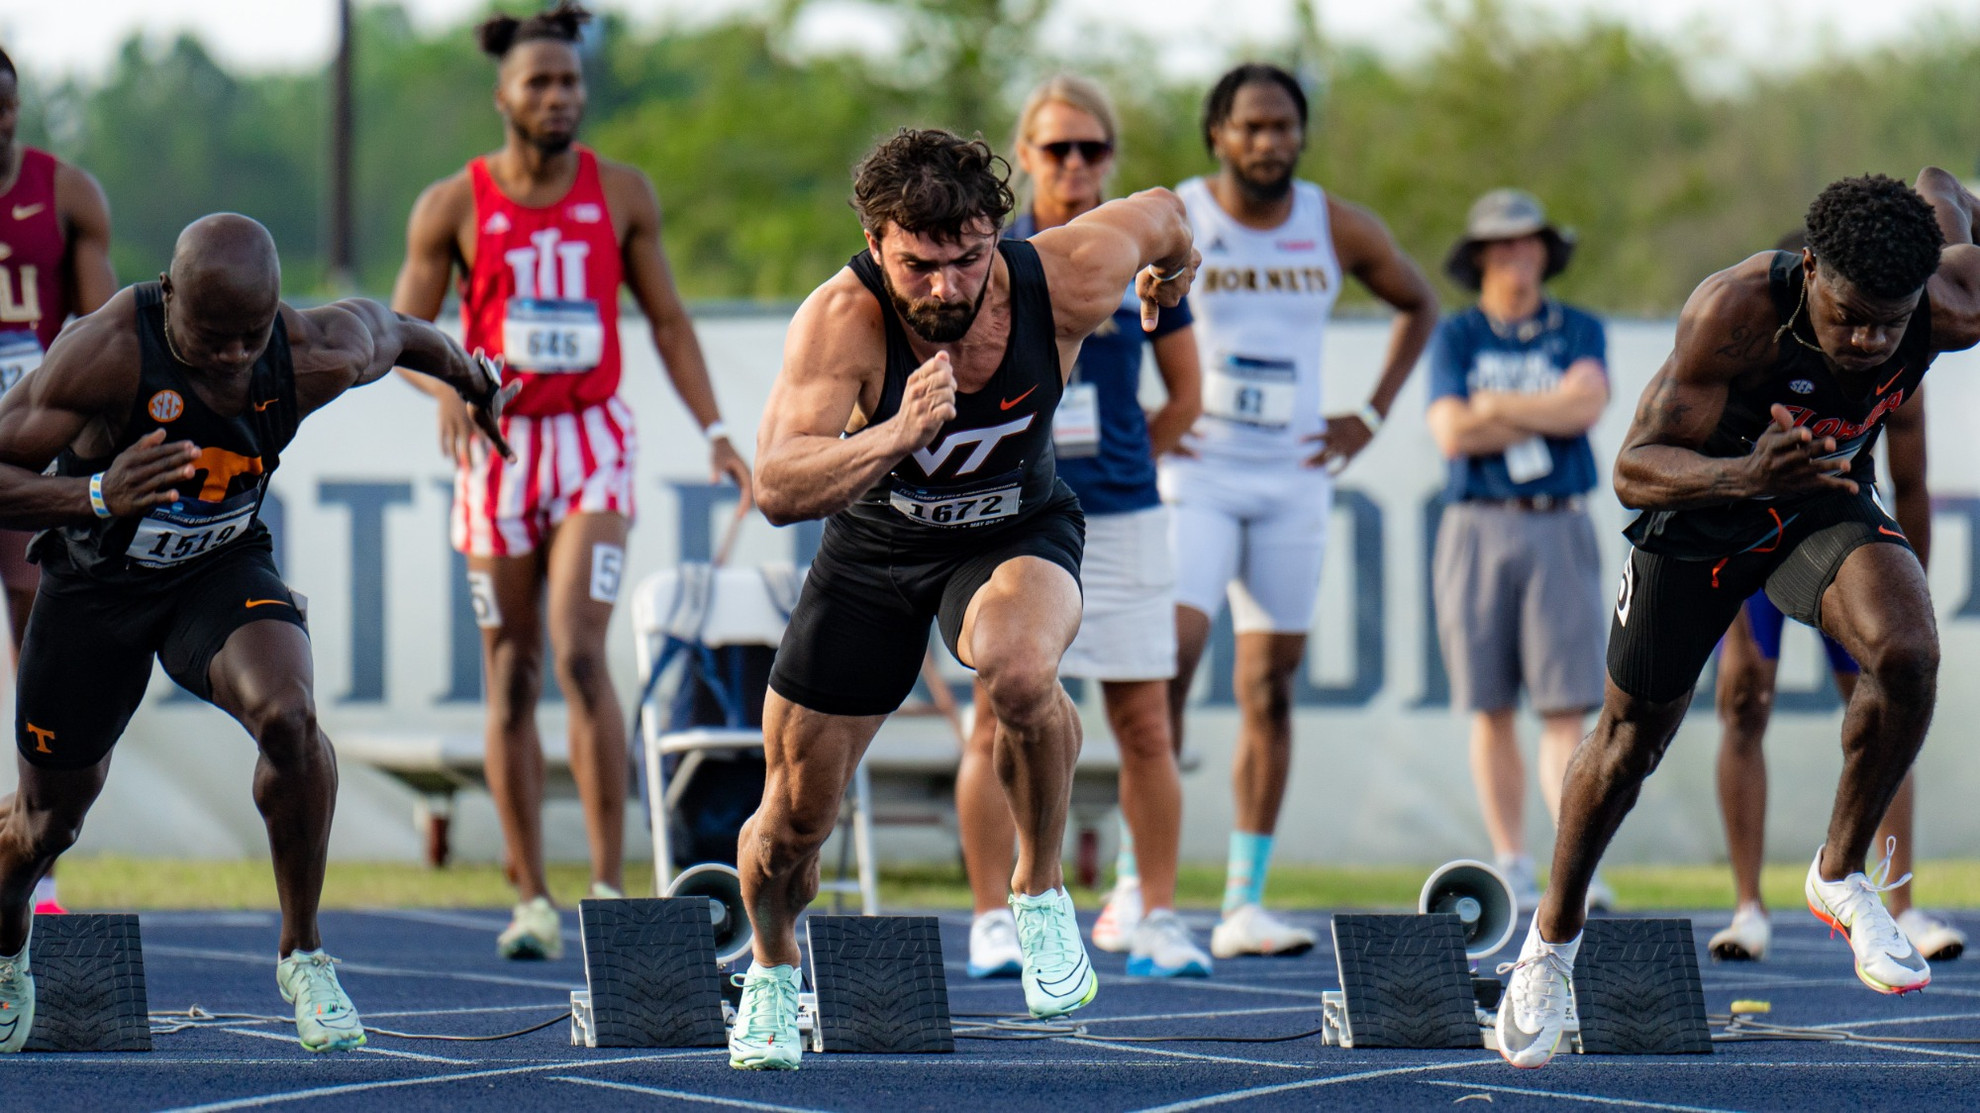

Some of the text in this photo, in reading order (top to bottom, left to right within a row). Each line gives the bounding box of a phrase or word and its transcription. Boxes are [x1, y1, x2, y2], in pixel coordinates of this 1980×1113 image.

[1203, 267, 1327, 292] HORNETS
[151, 391, 181, 420] SEC
[911, 411, 1037, 480] VT
[908, 495, 1004, 524] 1672
[147, 525, 237, 558] 1519
[599, 552, 618, 594] 5
[27, 722, 55, 754] T
